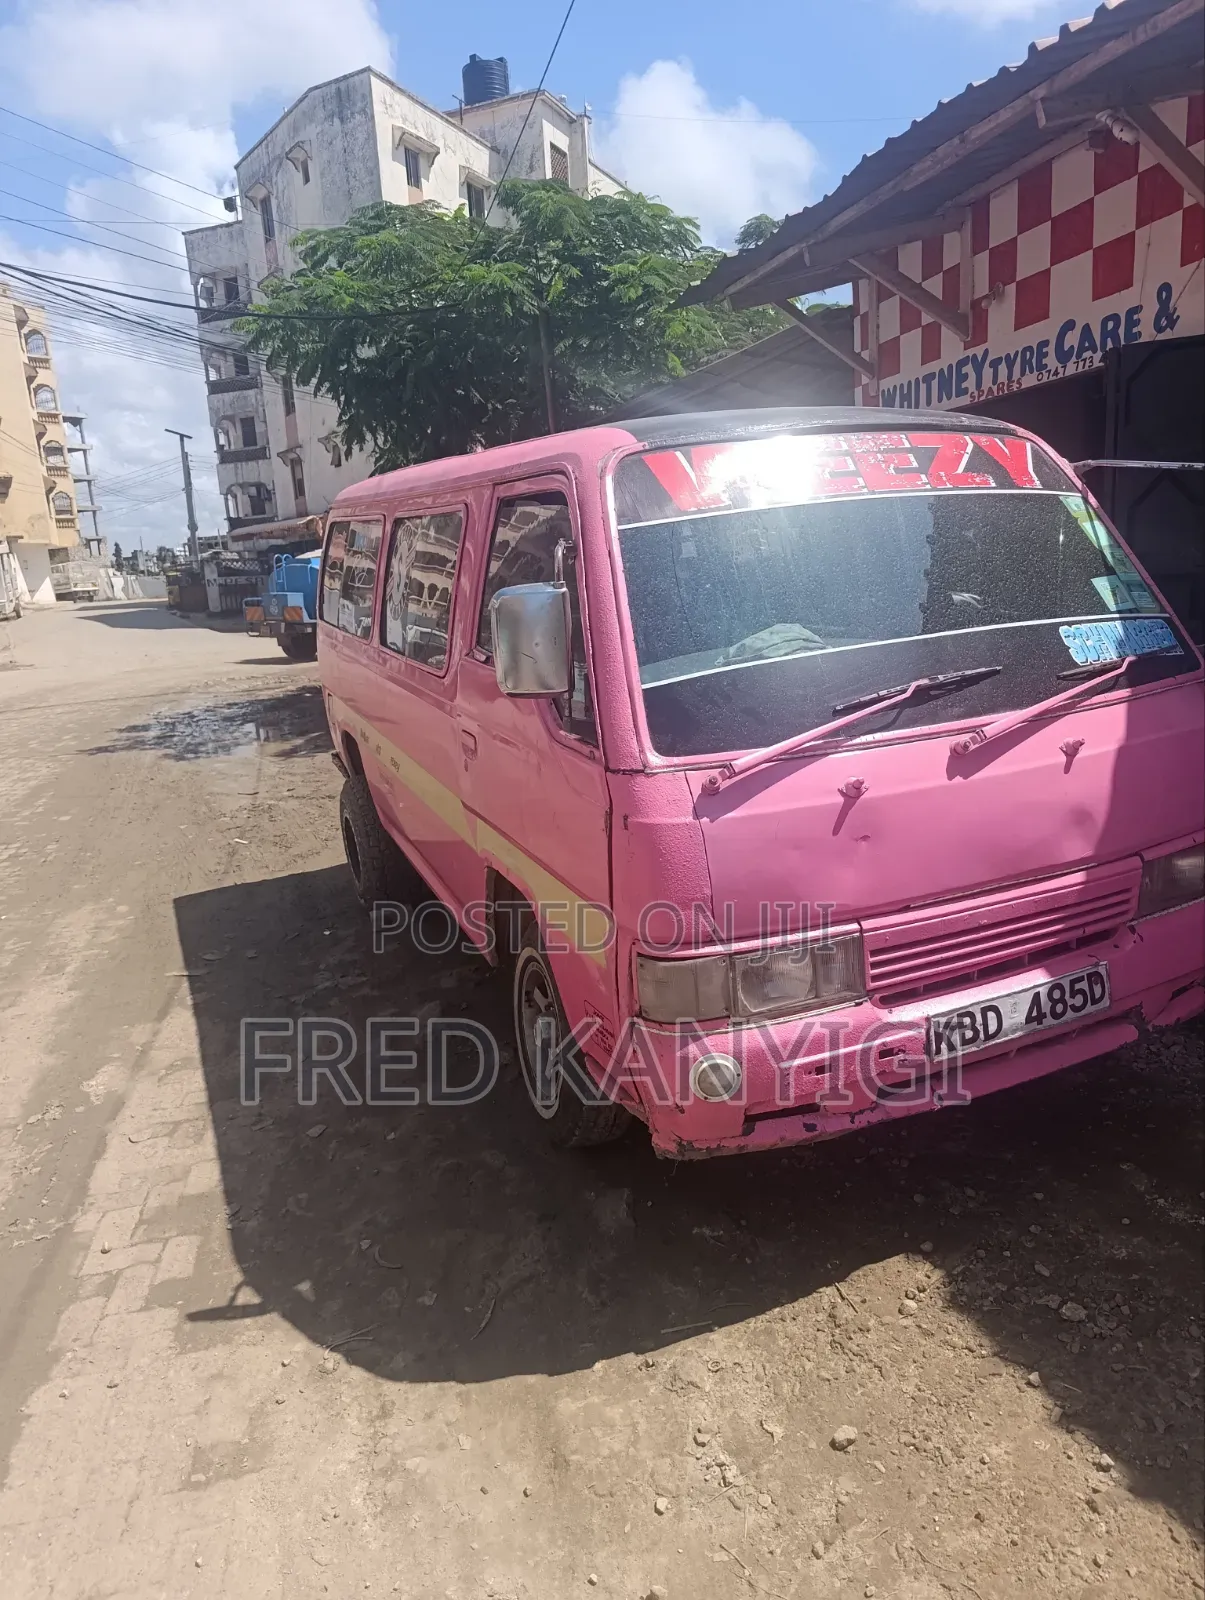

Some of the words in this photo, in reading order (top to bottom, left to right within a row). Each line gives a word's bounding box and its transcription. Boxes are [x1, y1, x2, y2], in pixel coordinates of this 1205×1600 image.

[881, 348, 989, 410] WHITNEY
[989, 339, 1050, 386] TYRE
[1054, 304, 1143, 365] CARE
[1153, 281, 1180, 334] &
[969, 377, 1023, 403] SPARES
[1036, 364, 1067, 382] 0747
[1073, 356, 1094, 372] 773
[933, 1004, 1004, 1056] KBD
[1024, 970, 1106, 1026] 485D
